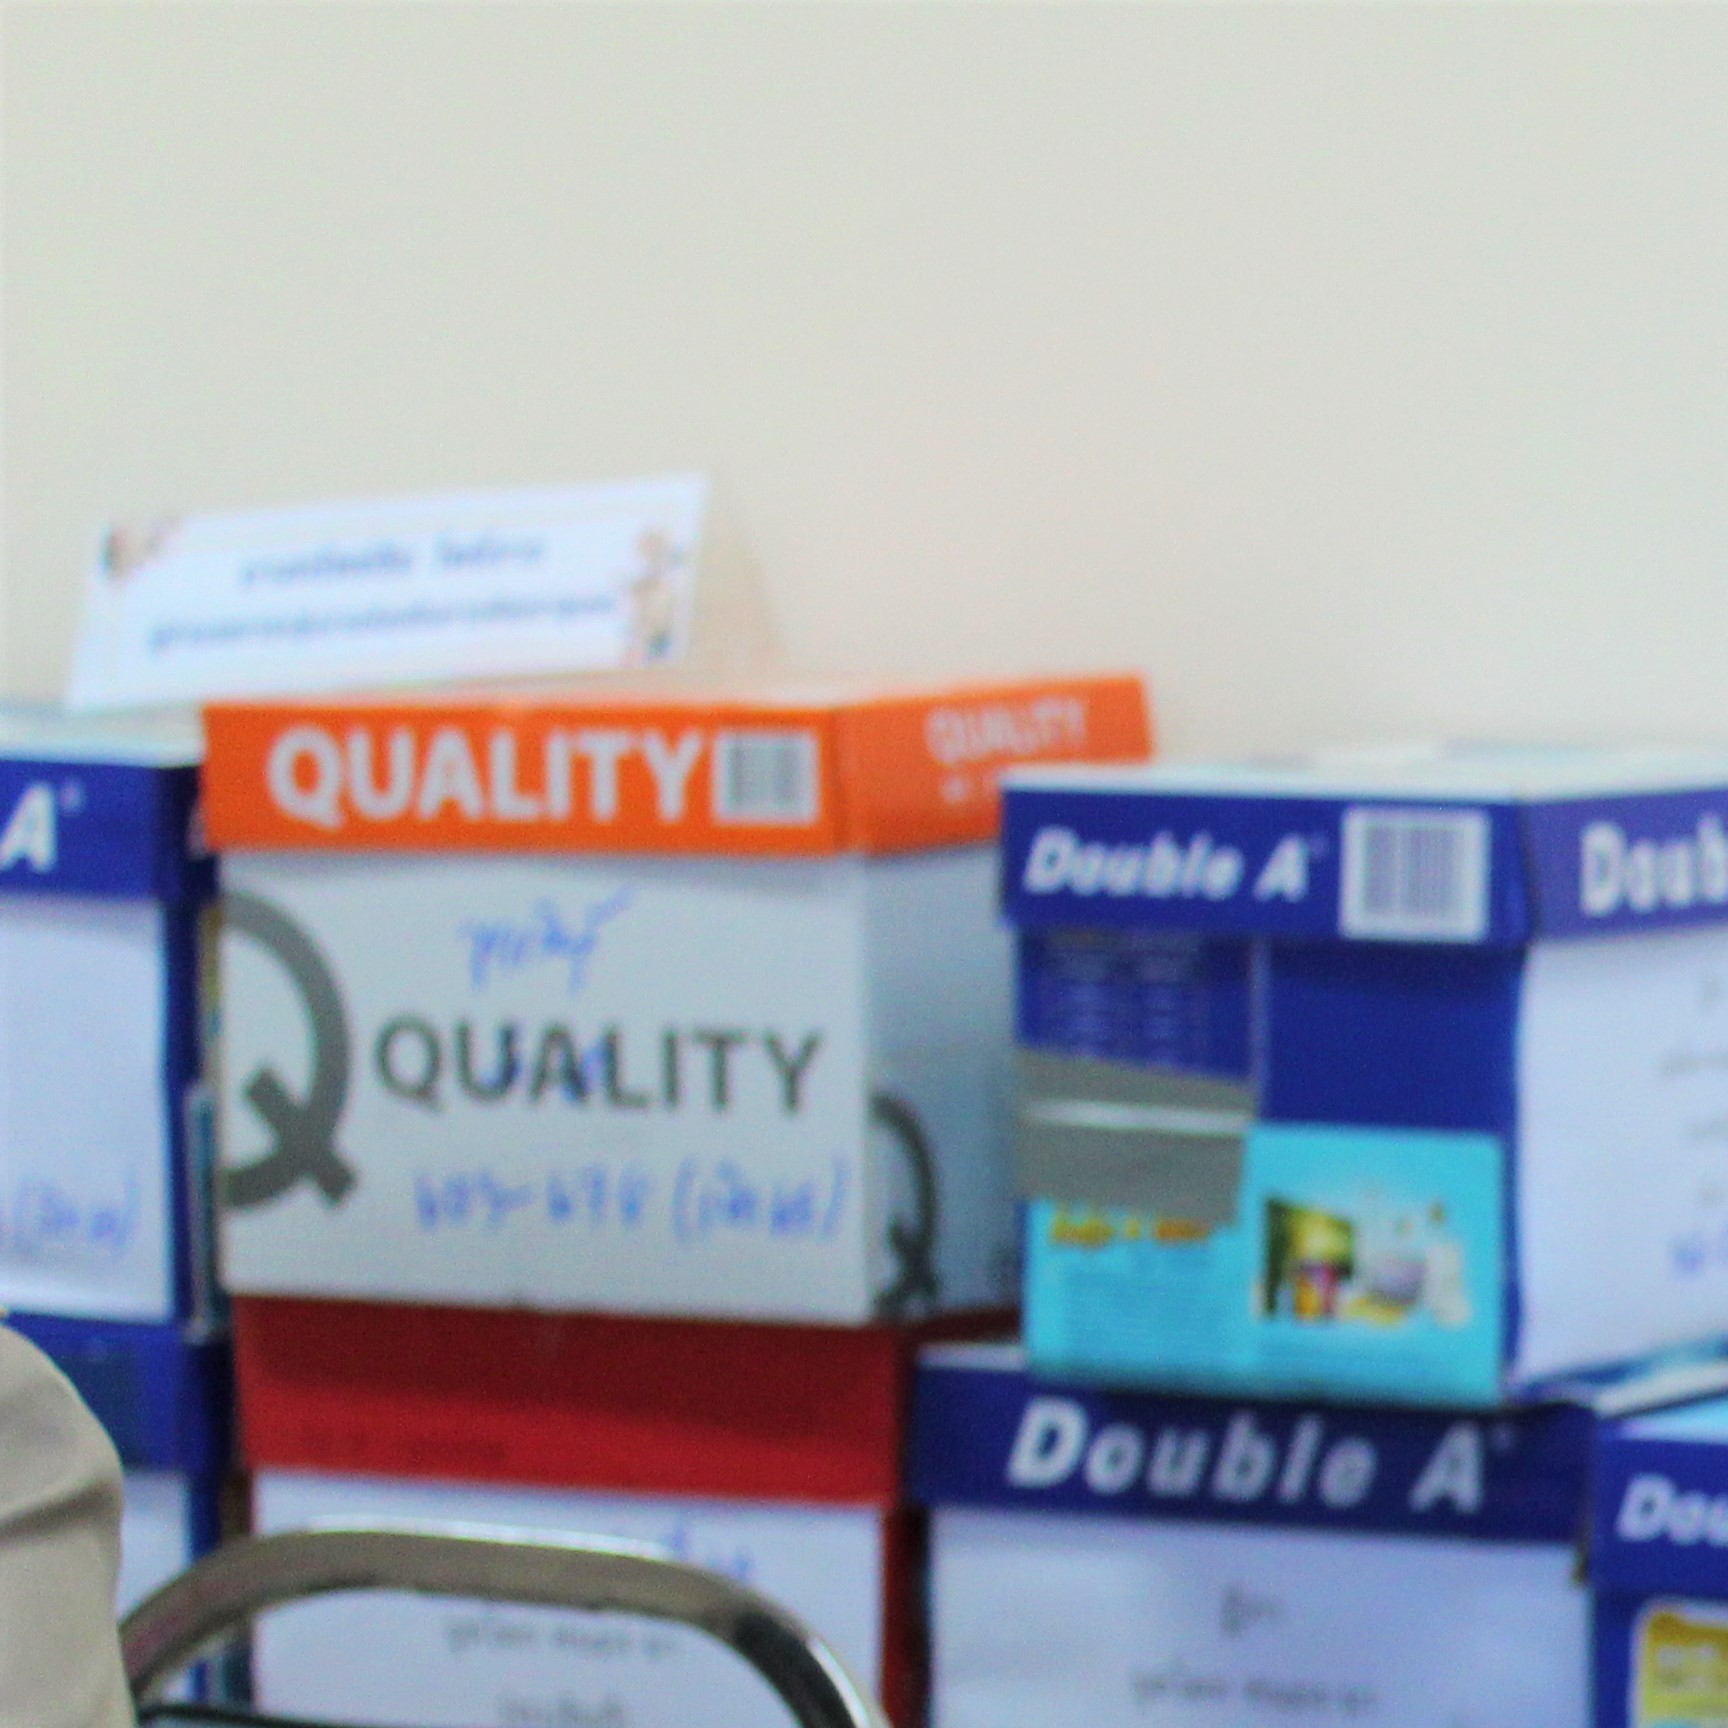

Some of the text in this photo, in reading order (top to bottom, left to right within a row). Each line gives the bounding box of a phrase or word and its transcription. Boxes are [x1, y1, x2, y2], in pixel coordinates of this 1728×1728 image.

[266, 725, 705, 830] QUALITY
[1022, 824, 1308, 901] Double A
[371, 1014, 824, 1114] QUALITY
[1007, 1397, 1487, 1514] Double A
